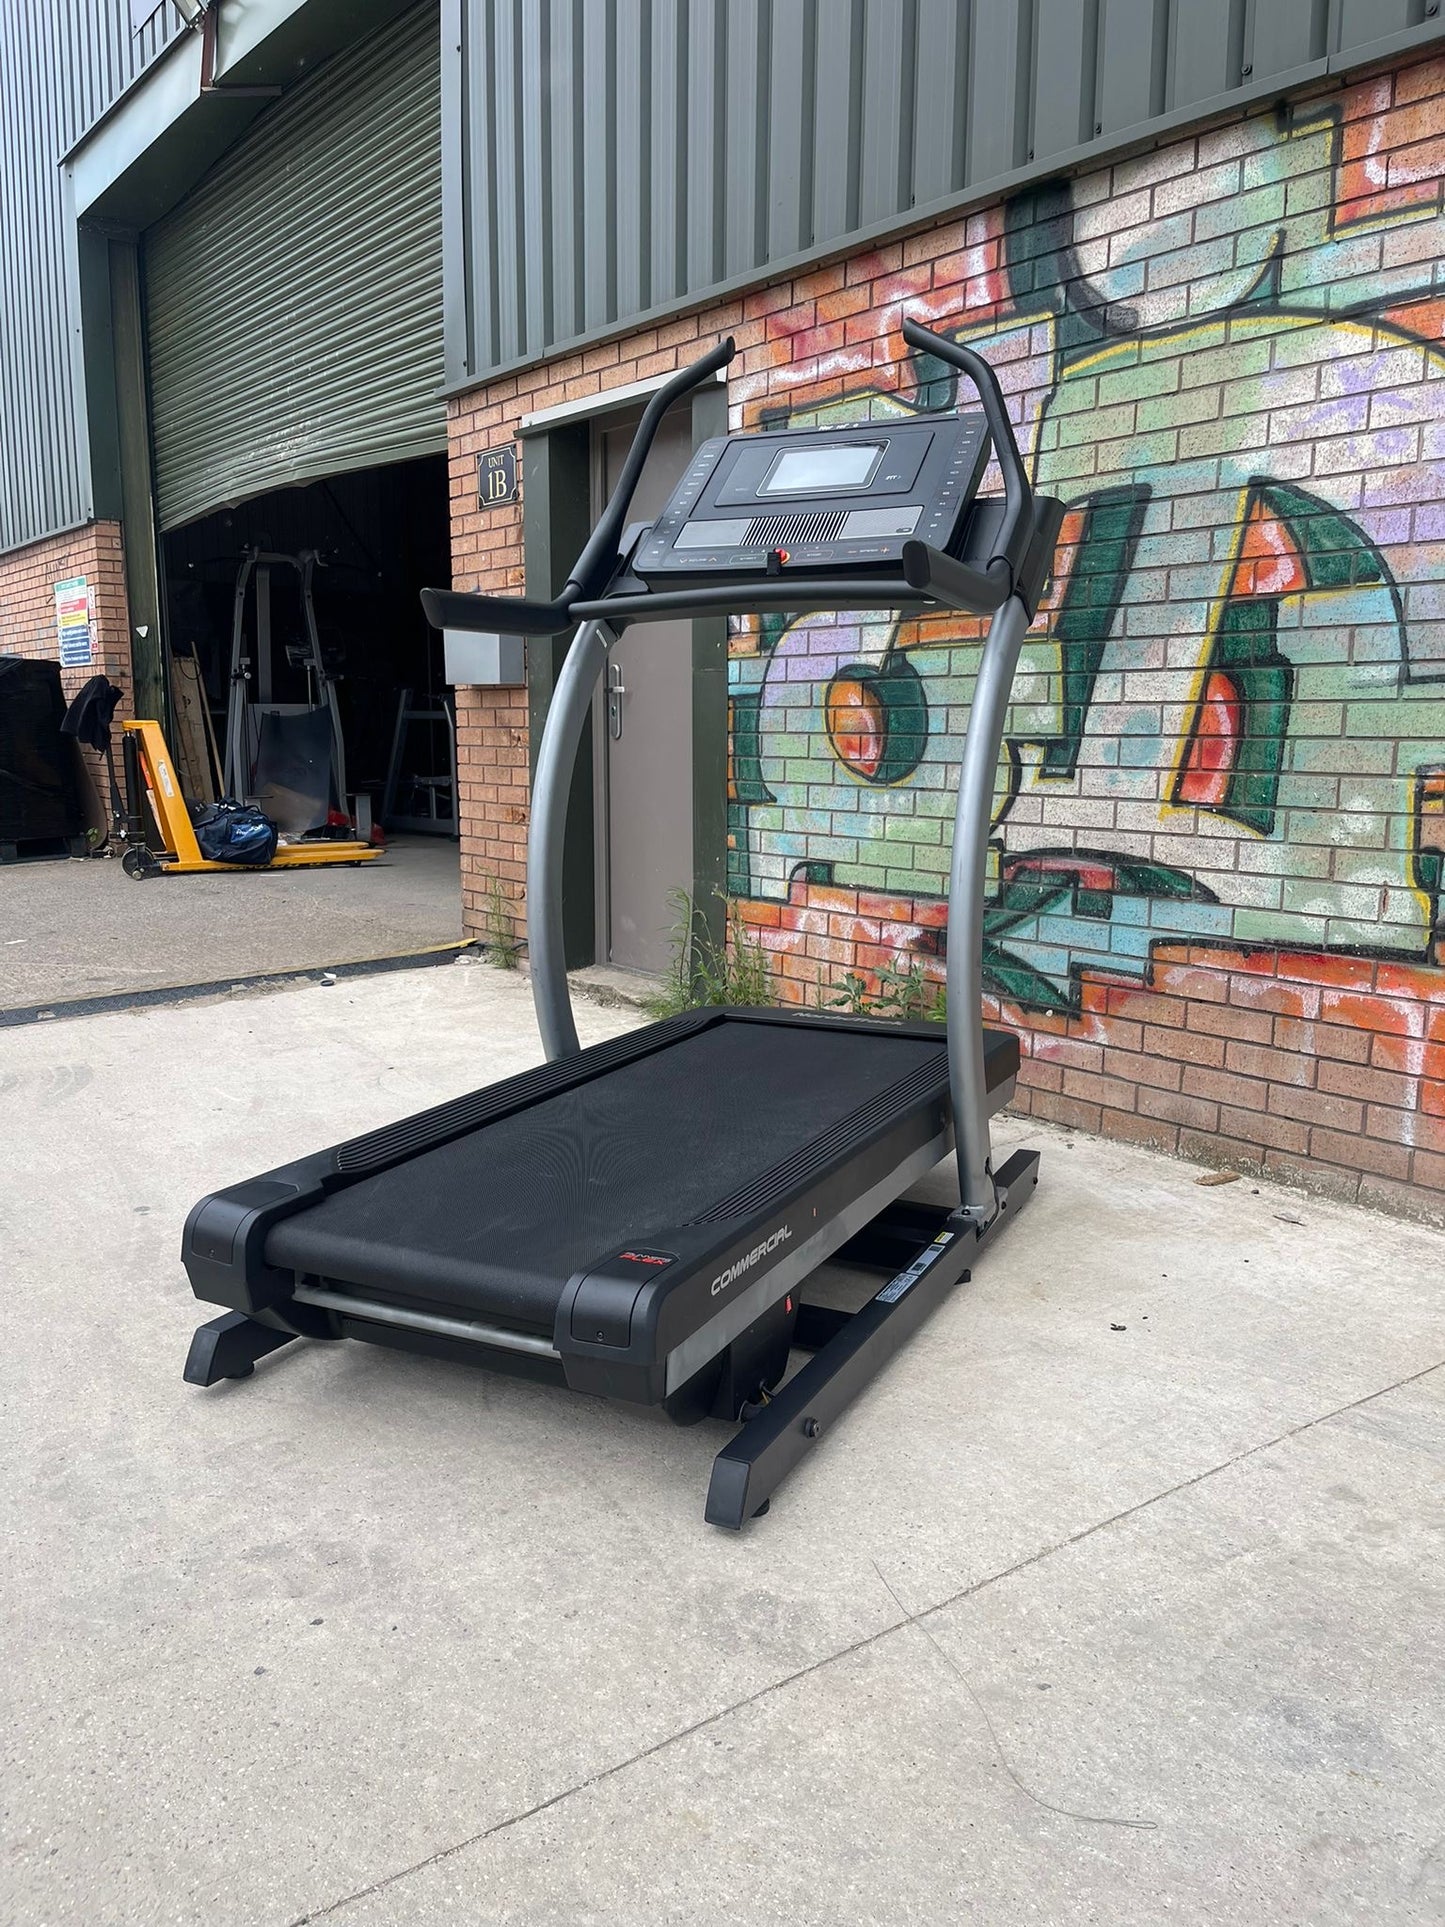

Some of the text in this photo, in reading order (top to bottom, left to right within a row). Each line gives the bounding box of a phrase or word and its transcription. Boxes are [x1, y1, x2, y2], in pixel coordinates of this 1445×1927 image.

[488, 455, 504, 468] UNIT
[488, 470, 507, 499] 1B
[710, 1224, 793, 1296] COMMERCIAL
